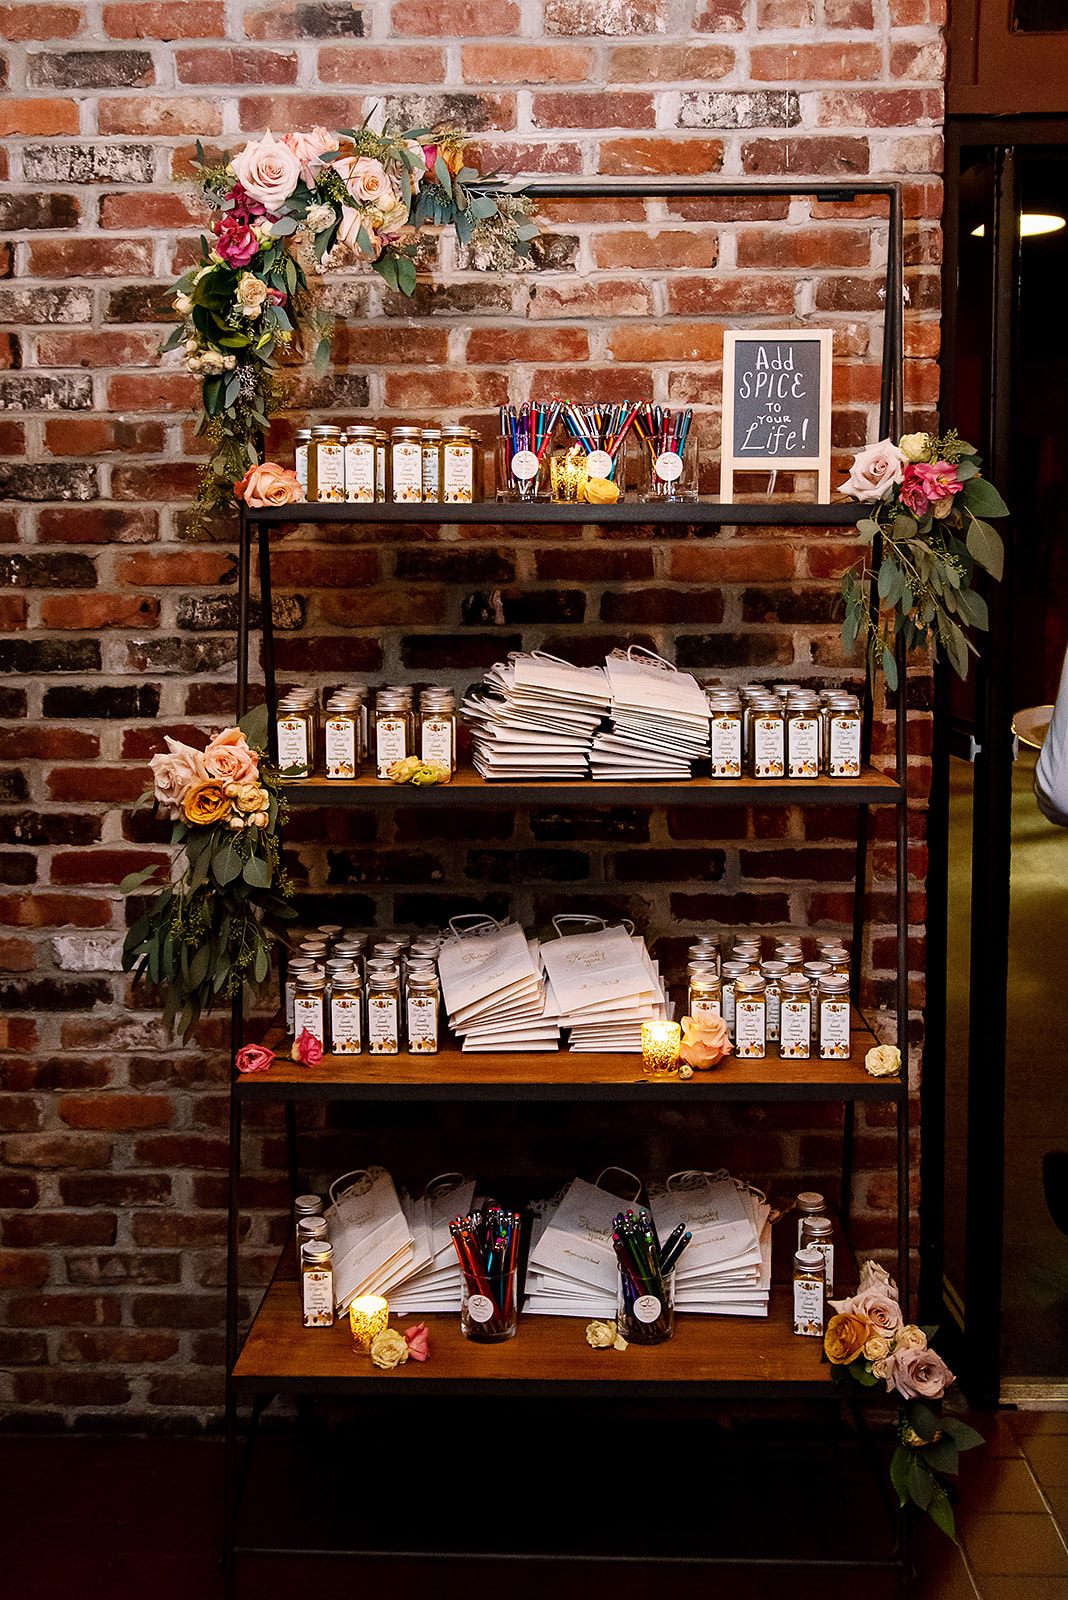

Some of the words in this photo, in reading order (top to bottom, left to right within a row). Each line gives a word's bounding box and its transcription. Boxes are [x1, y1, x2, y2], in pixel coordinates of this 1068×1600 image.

[755, 346, 795, 371] Add
[739, 371, 806, 399] SPICE
[765, 402, 782, 413] TO
[740, 418, 809, 454] Life!
